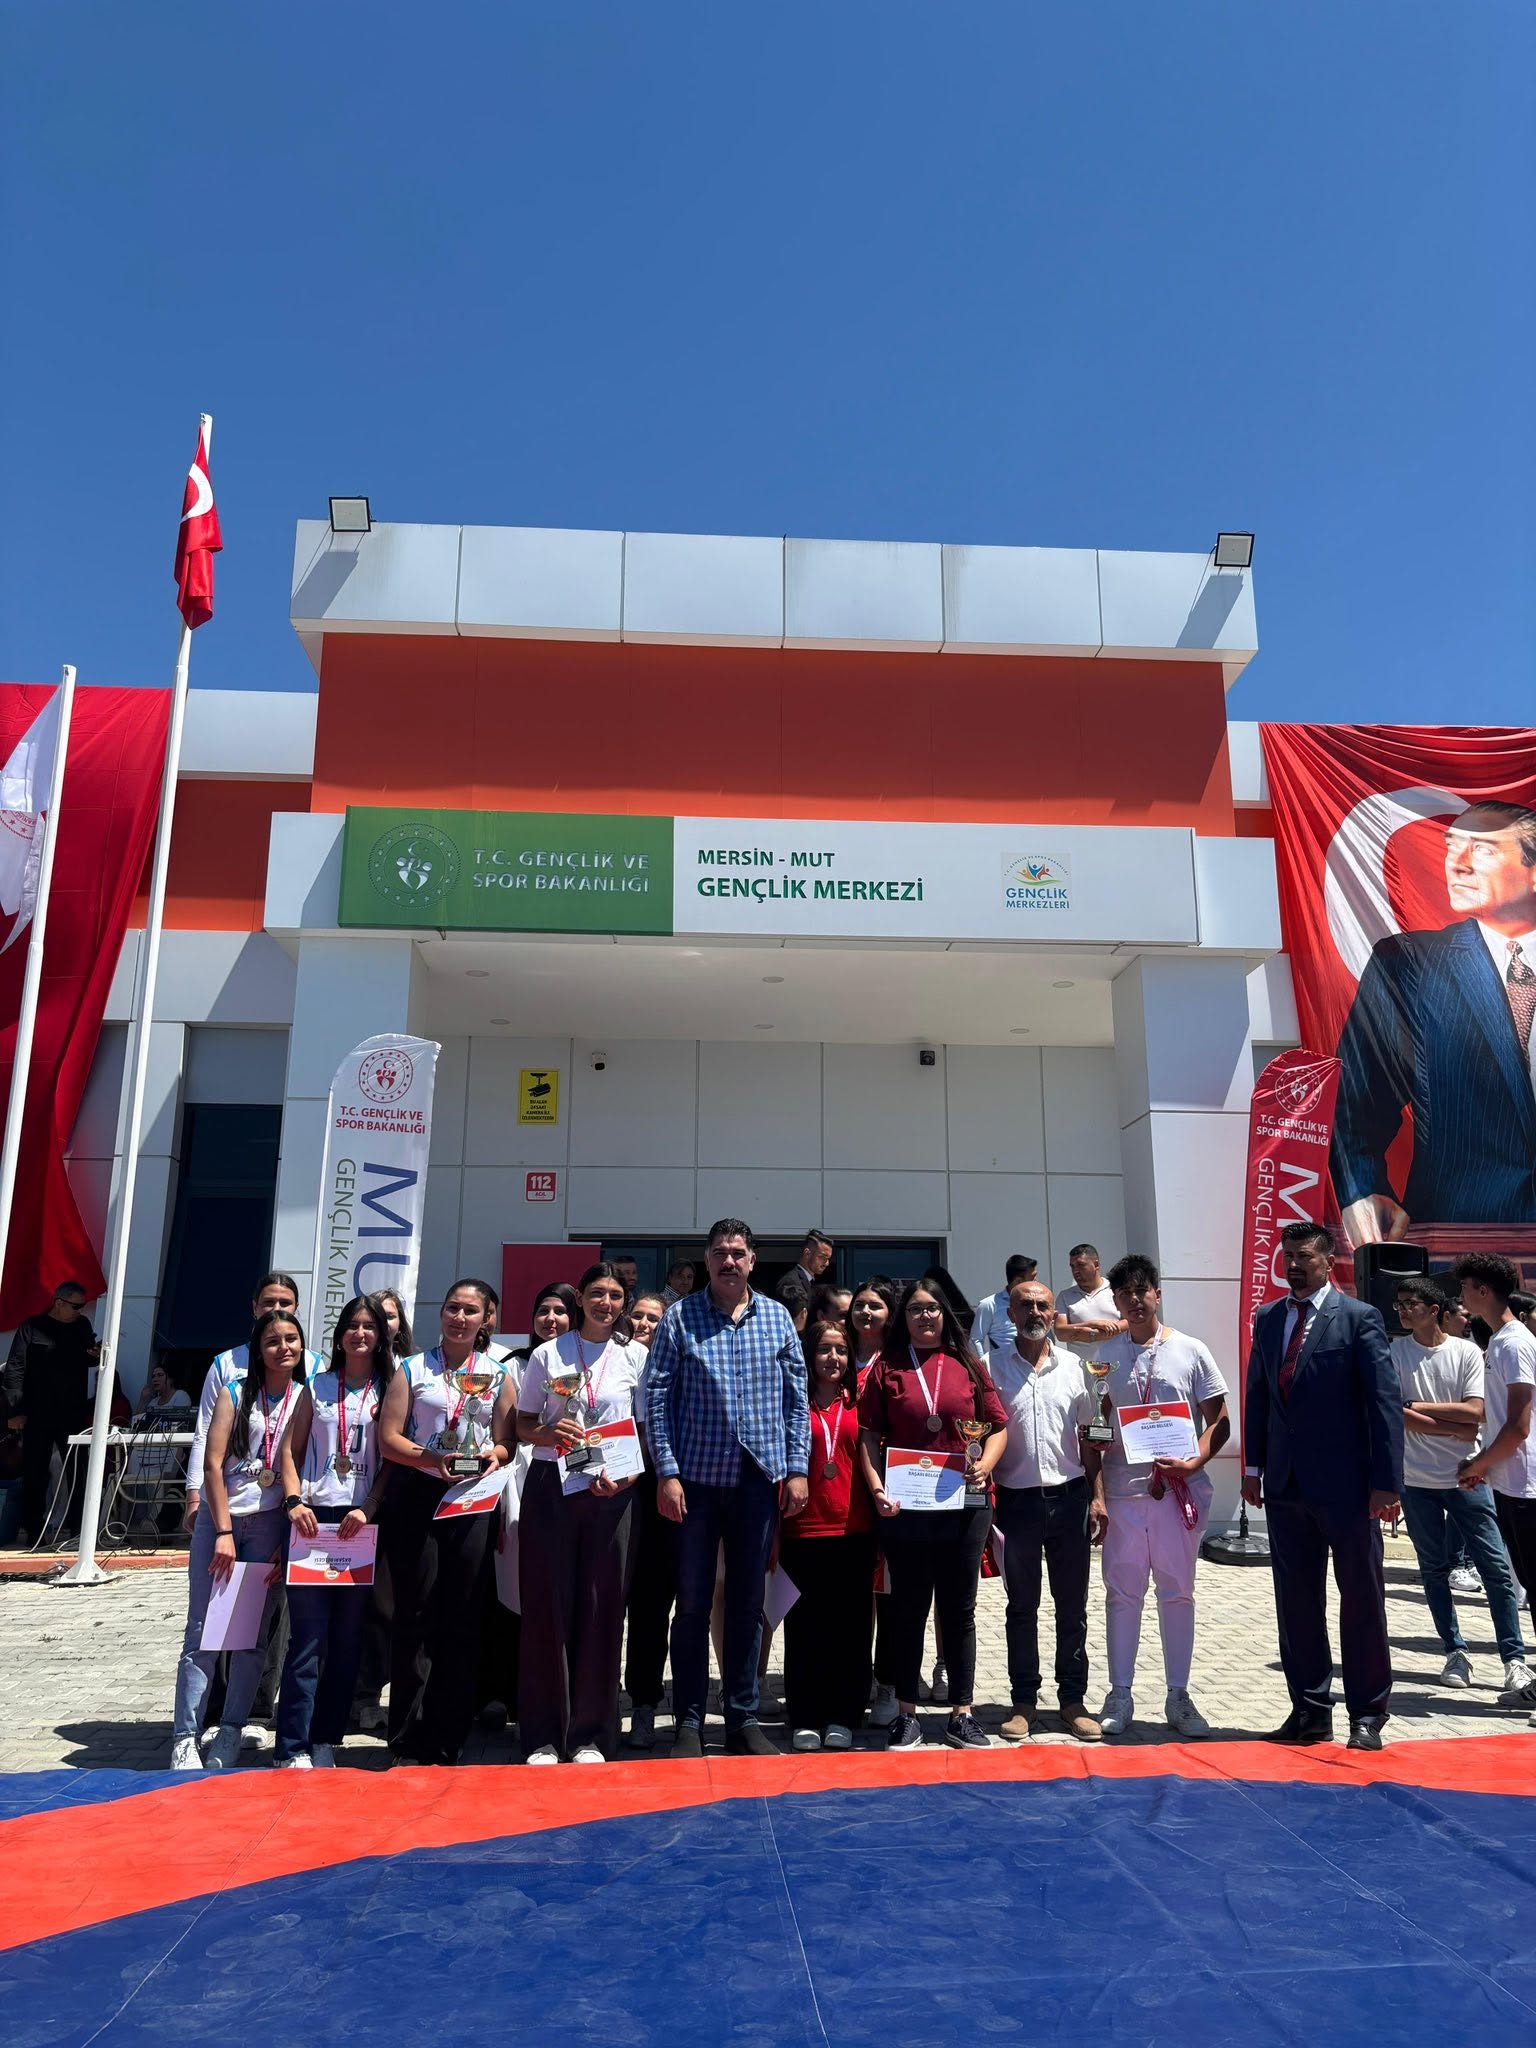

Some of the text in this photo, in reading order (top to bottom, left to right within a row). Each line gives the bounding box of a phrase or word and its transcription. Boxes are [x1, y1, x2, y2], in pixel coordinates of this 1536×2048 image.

[474, 849, 649, 871] T.C. GENÇLİK VE
[697, 848, 774, 866] MERSİN
[790, 852, 835, 867] MUT
[473, 872, 649, 892] SPOR BAKANLIĞI
[697, 875, 924, 904] GENÇLİK MERKEZİ
[1006, 887, 1068, 900] GENÇLİK
[340, 1105, 423, 1121] T.C. GENÇLİK VE
[336, 1118, 426, 1134] SPOR BAKANLIĞI
[1260, 1114, 1329, 1134] T.C. GENÇLİK VE
[1256, 1125, 1329, 1146] SPOR BAKANLIĞI
[531, 1175, 552, 1190] 112
[328, 1158, 357, 1260] GENÇLİK
[1252, 1157, 1275, 1248] GENÇLİK
